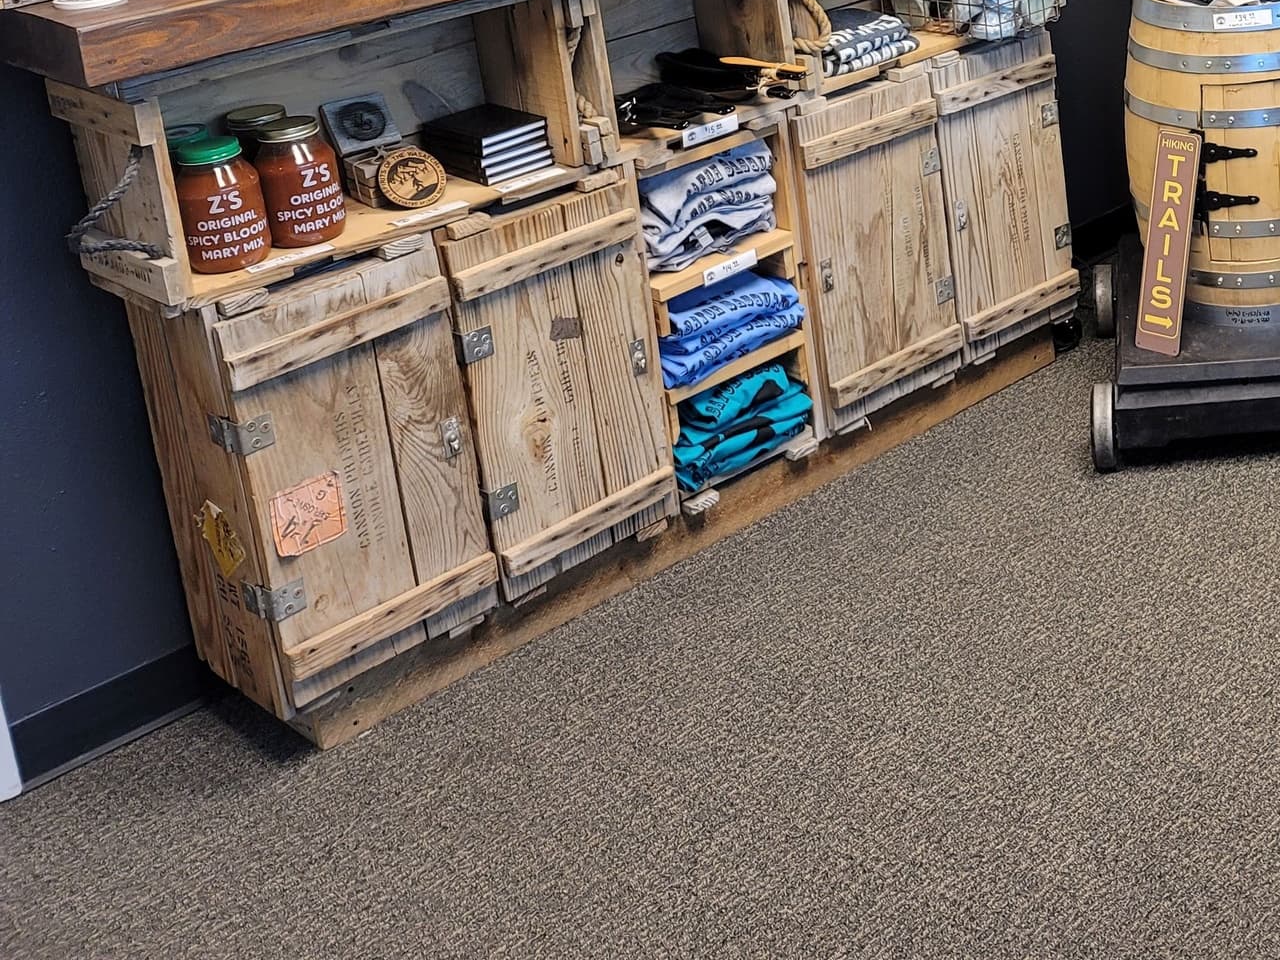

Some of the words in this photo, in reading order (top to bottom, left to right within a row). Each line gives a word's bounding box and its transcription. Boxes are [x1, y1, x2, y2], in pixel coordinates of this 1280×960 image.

[1162, 138, 1194, 153] HIKING
[301, 165, 331, 188] Z'S
[207, 191, 242, 214] Z'S
[290, 182, 342, 206] ORIGINAL
[197, 209, 258, 231] ORIGINAL
[277, 207, 313, 222] SPICY
[294, 218, 331, 234] MARY
[189, 234, 223, 246] SPICY
[224, 218, 268, 243] BLOODY
[1149, 154, 1186, 310] TRAILS
[202, 245, 240, 261] MARY
[243, 236, 265, 253] MIX
[346, 384, 374, 476] CAREFULLY
[333, 411, 359, 484] PRIMERS
[541, 434, 559, 493] CANNON
[315, 489, 327, 502] G
[349, 488, 371, 549] CANNON
[365, 480, 386, 542] HANDLE
